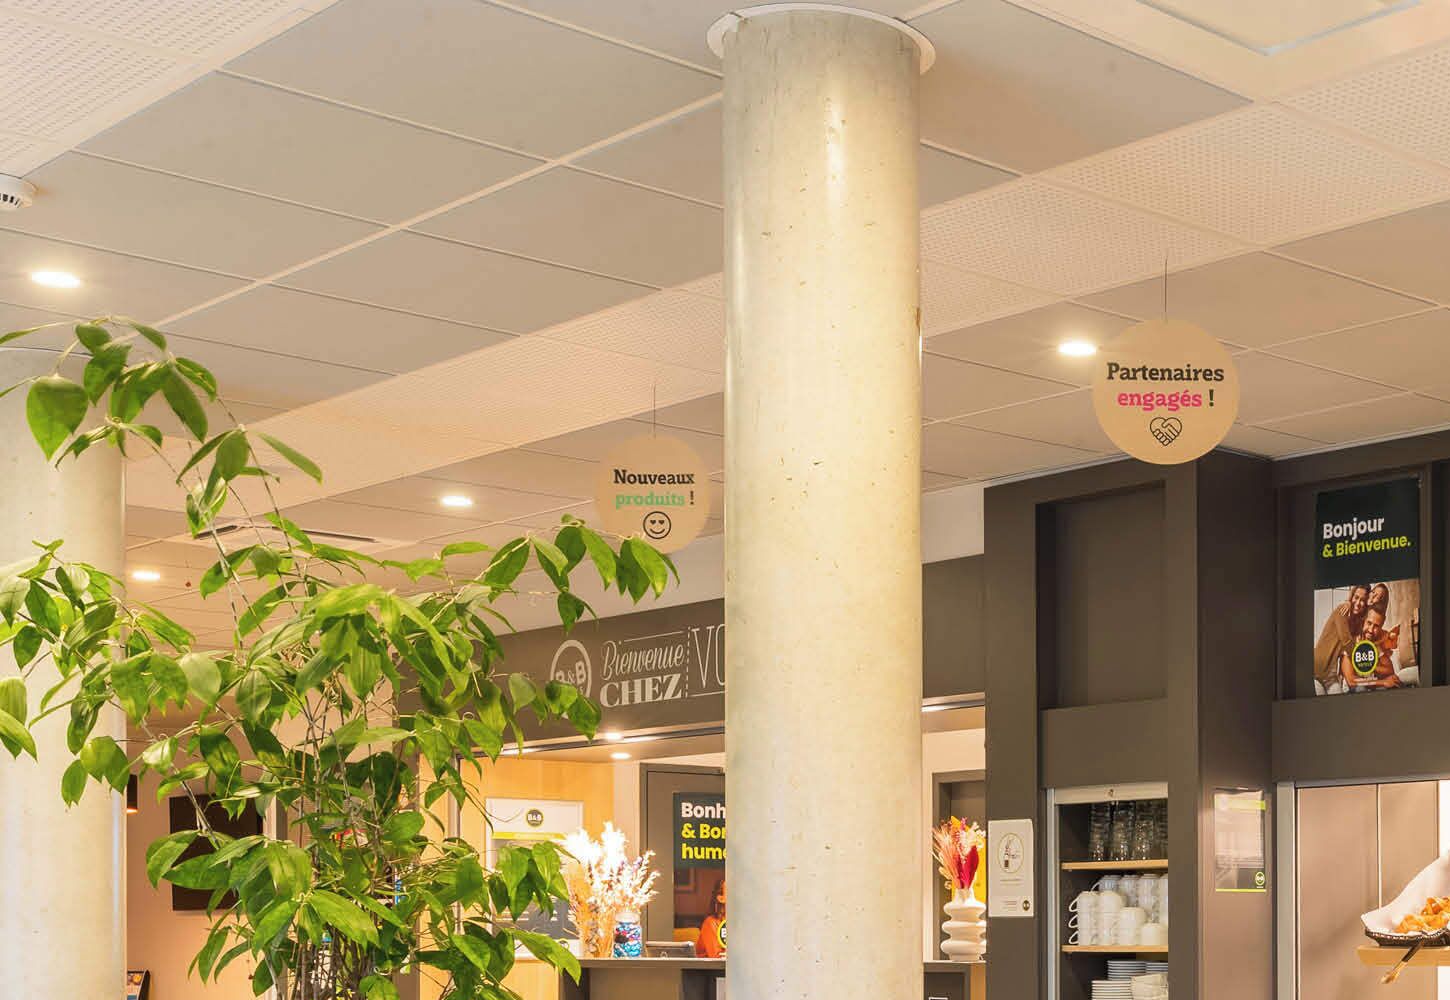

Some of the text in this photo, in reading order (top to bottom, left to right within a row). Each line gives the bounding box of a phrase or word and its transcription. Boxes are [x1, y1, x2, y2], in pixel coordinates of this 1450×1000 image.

[1106, 362, 1225, 381] Partenaires
[1117, 389, 1214, 412] engagés !
[613, 469, 695, 485] Nouveaux
[615, 490, 694, 510] produits !
[1323, 517, 1384, 540] Bonjour
[1322, 535, 1411, 558] & Bienvenue.
[601, 640, 684, 681] Bienvenue
[1355, 650, 1375, 663] B&B
[600, 672, 683, 708] CHEZ
[681, 823, 696, 839] &
